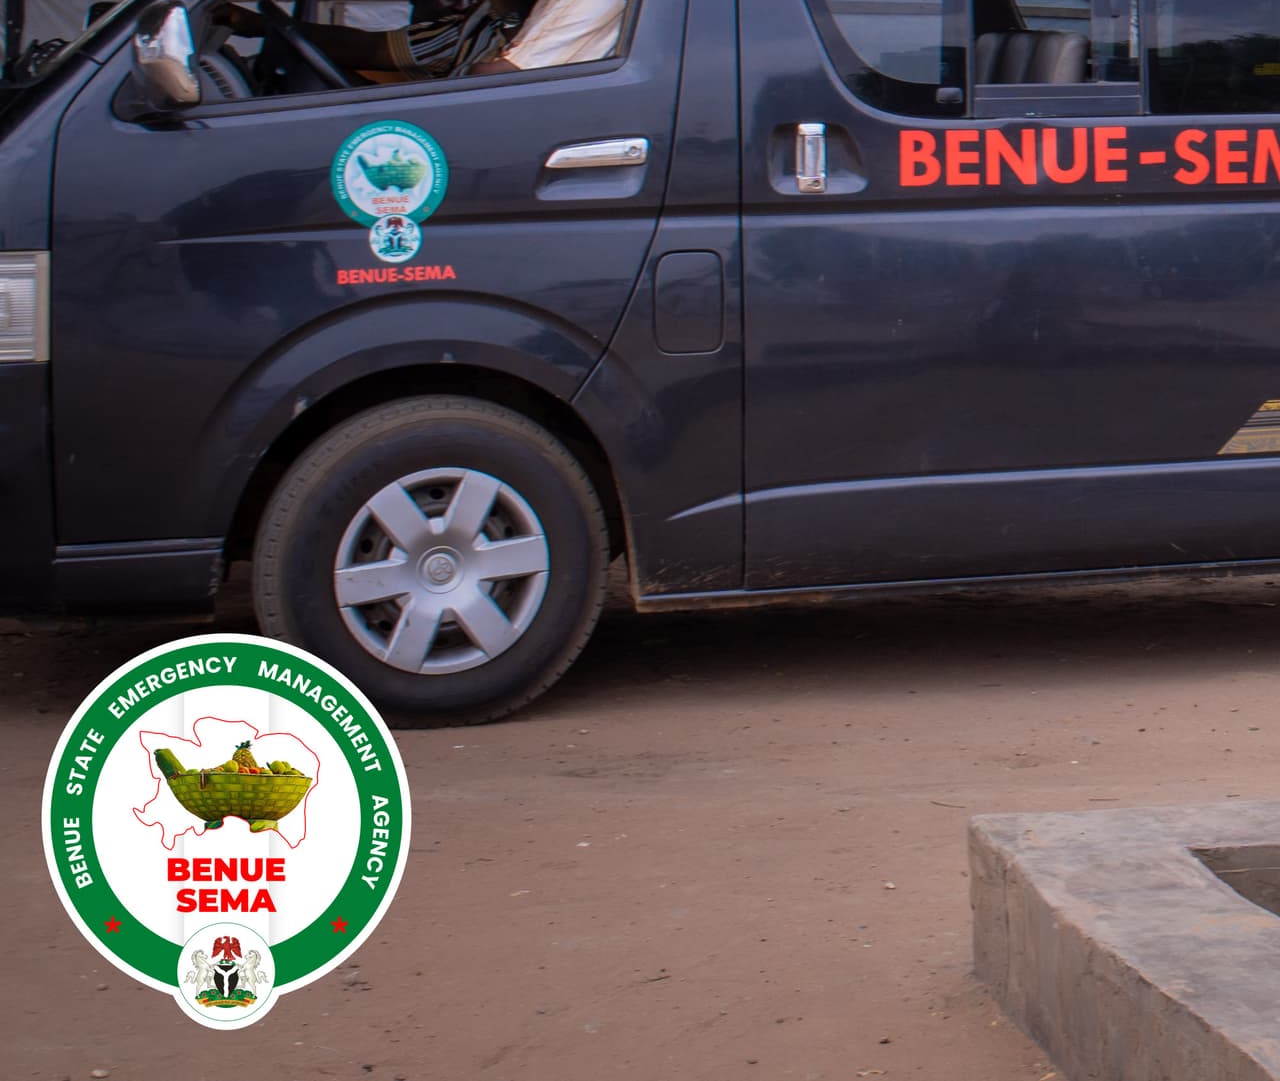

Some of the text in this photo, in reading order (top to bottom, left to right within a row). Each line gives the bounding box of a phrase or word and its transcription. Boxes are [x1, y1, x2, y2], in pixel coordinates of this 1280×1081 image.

[372, 195, 408, 204] BENUE
[375, 206, 407, 214] SEMA
[336, 265, 456, 285] BENUE-SEMA
